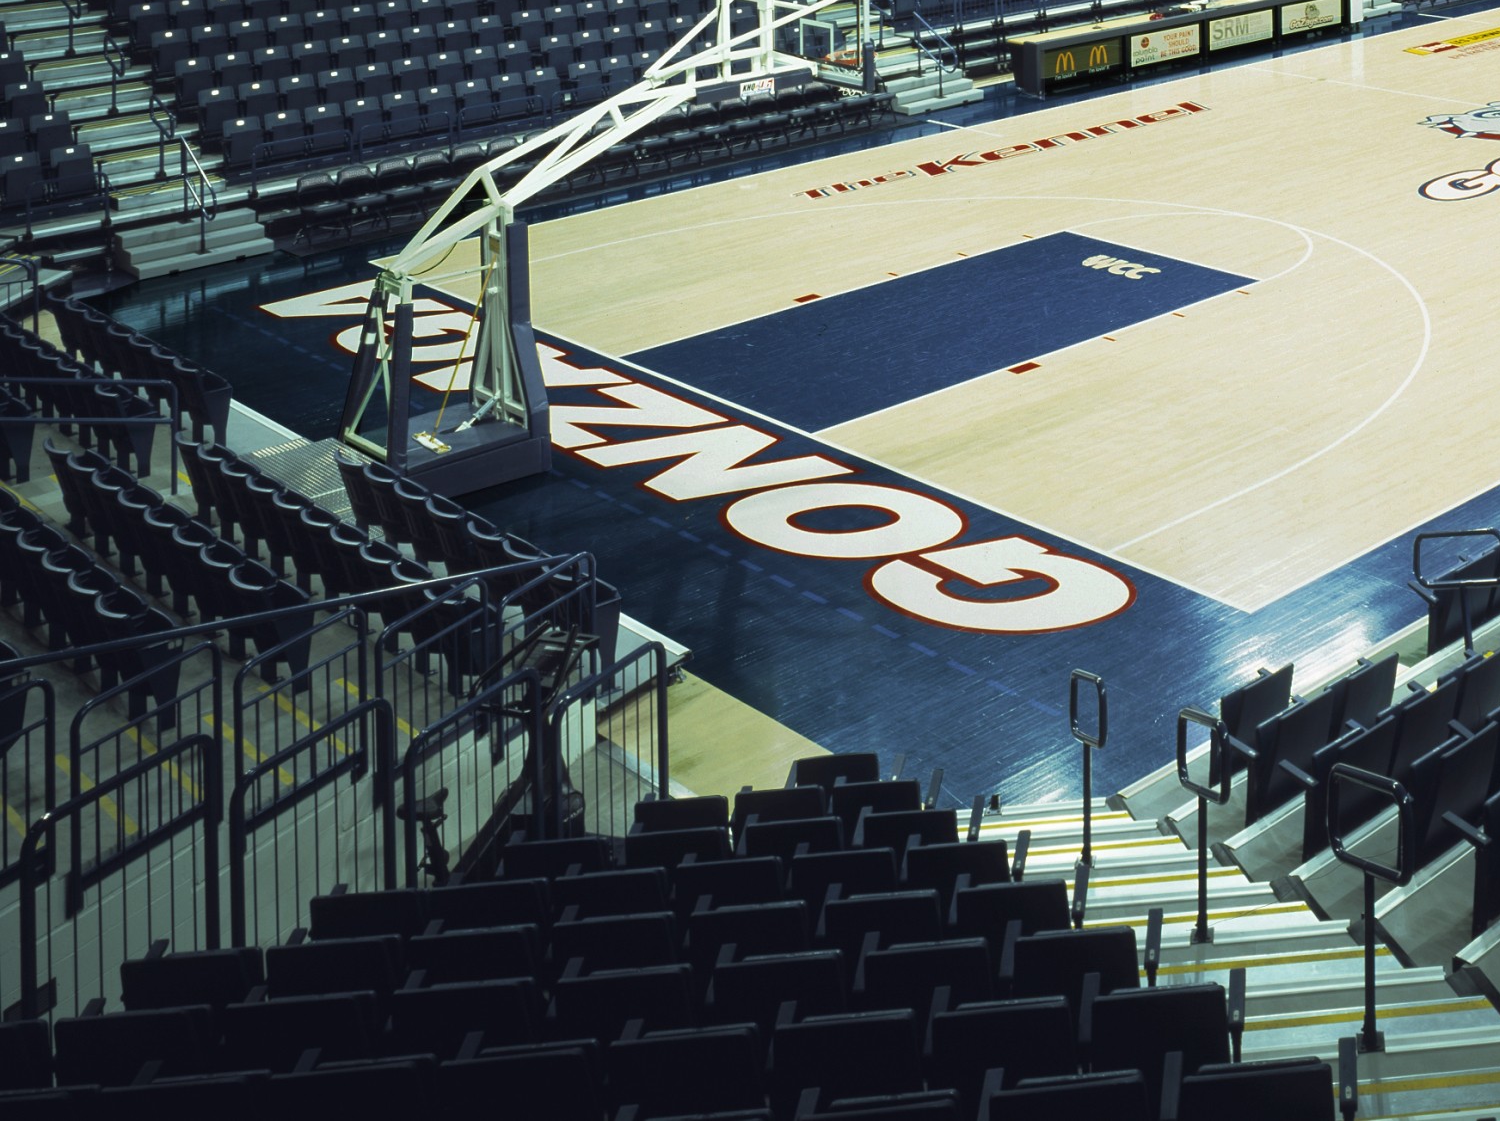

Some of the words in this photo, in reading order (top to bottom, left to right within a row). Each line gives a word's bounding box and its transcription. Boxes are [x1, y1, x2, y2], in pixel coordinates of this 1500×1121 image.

[1213, 15, 1249, 40] SRM
[1135, 55, 1155, 64] paint
[792, 170, 917, 199] The
[916, 100, 1211, 177] Kennel
[1081, 255, 1161, 280] WCC
[258, 279, 1138, 633] GONZAGA
